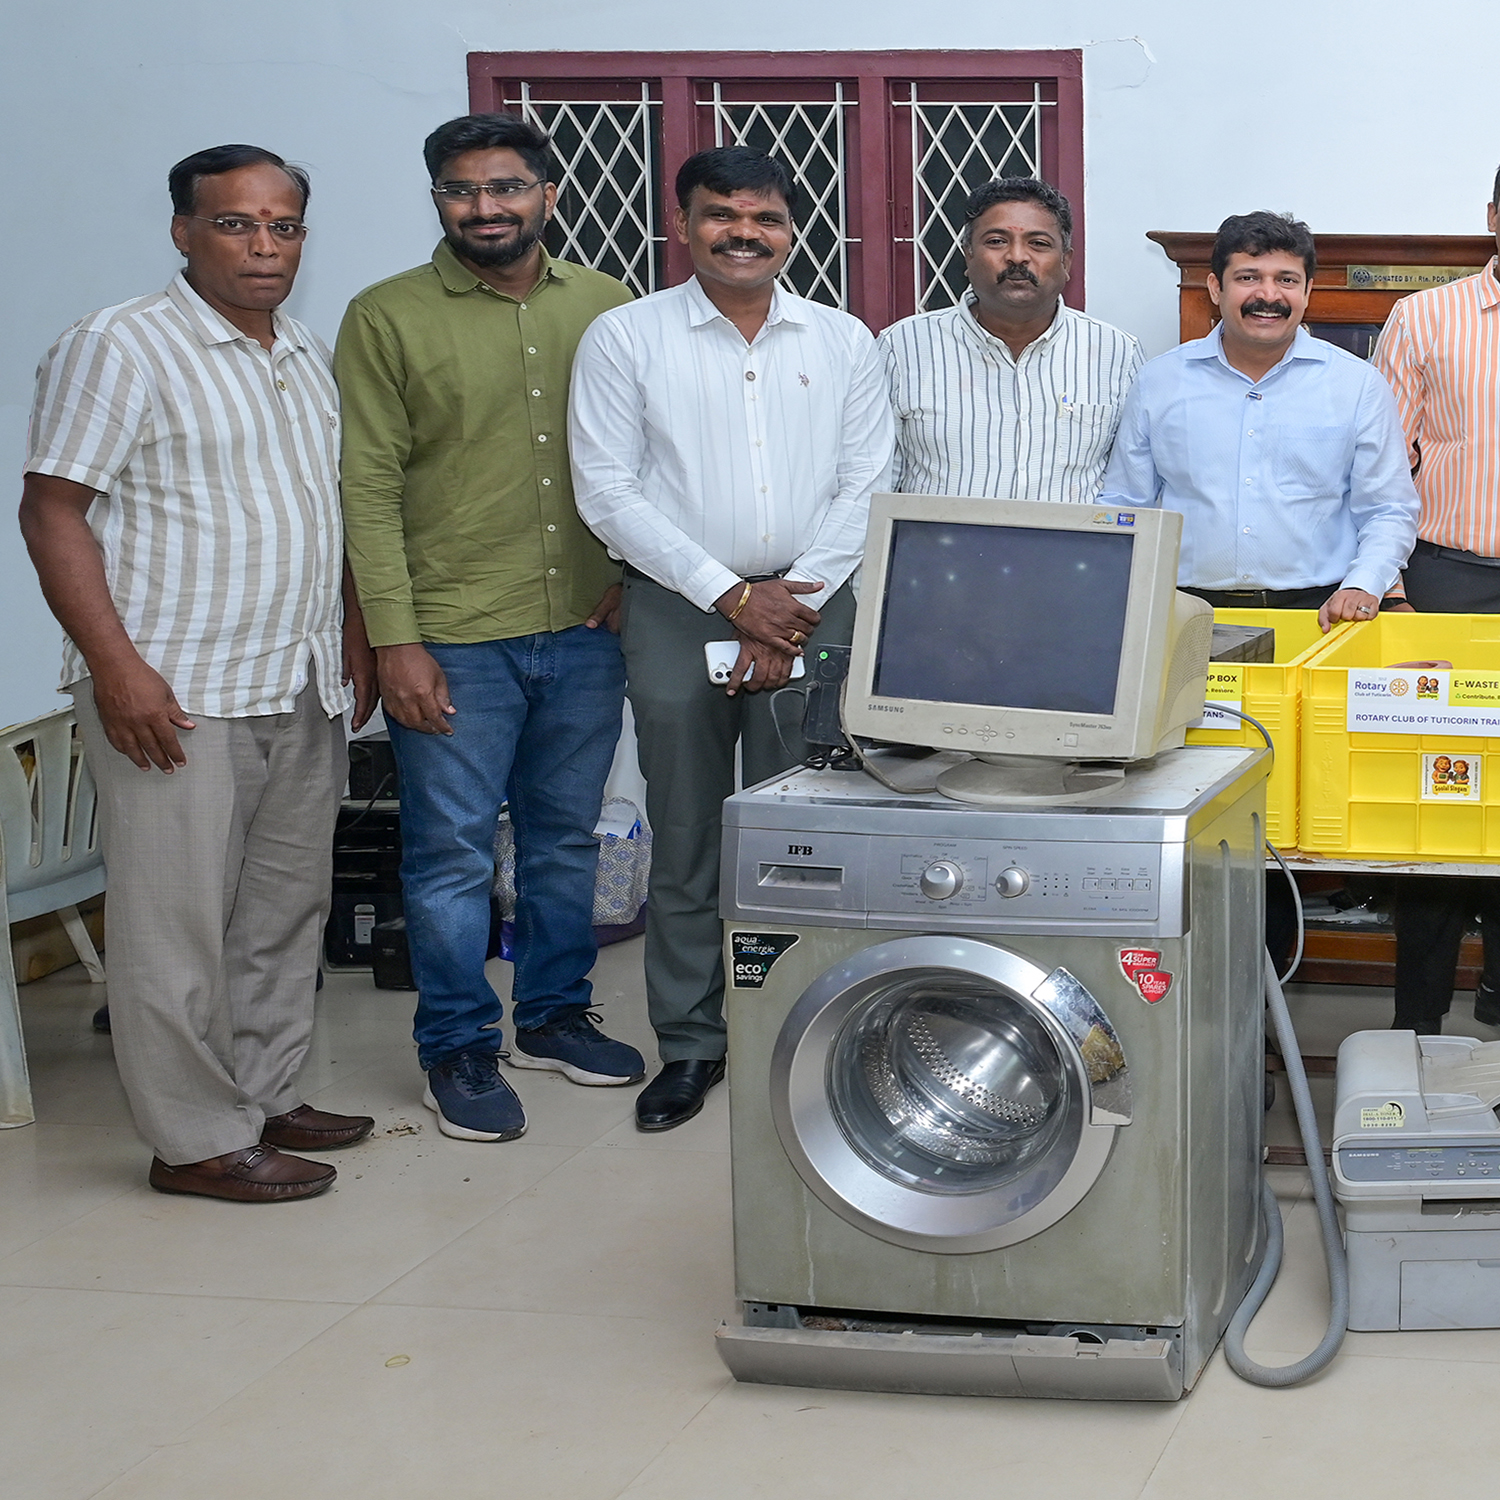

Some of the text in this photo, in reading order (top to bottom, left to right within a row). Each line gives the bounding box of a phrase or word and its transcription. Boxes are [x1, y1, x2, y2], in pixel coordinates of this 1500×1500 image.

[1354, 680, 1387, 692] Rotary
[1454, 680, 1499, 688] E-WASTE
[868, 704, 904, 713] SAMSUNG
[1431, 716, 1478, 724] TUTICORIN
[788, 845, 812, 855] IFB
[734, 936, 758, 944] aqua
[742, 945, 775, 955] energie
[1121, 952, 1133, 965] 4
[736, 964, 762, 974] eco
[736, 974, 763, 983] savings
[1138, 974, 1154, 985] 10
